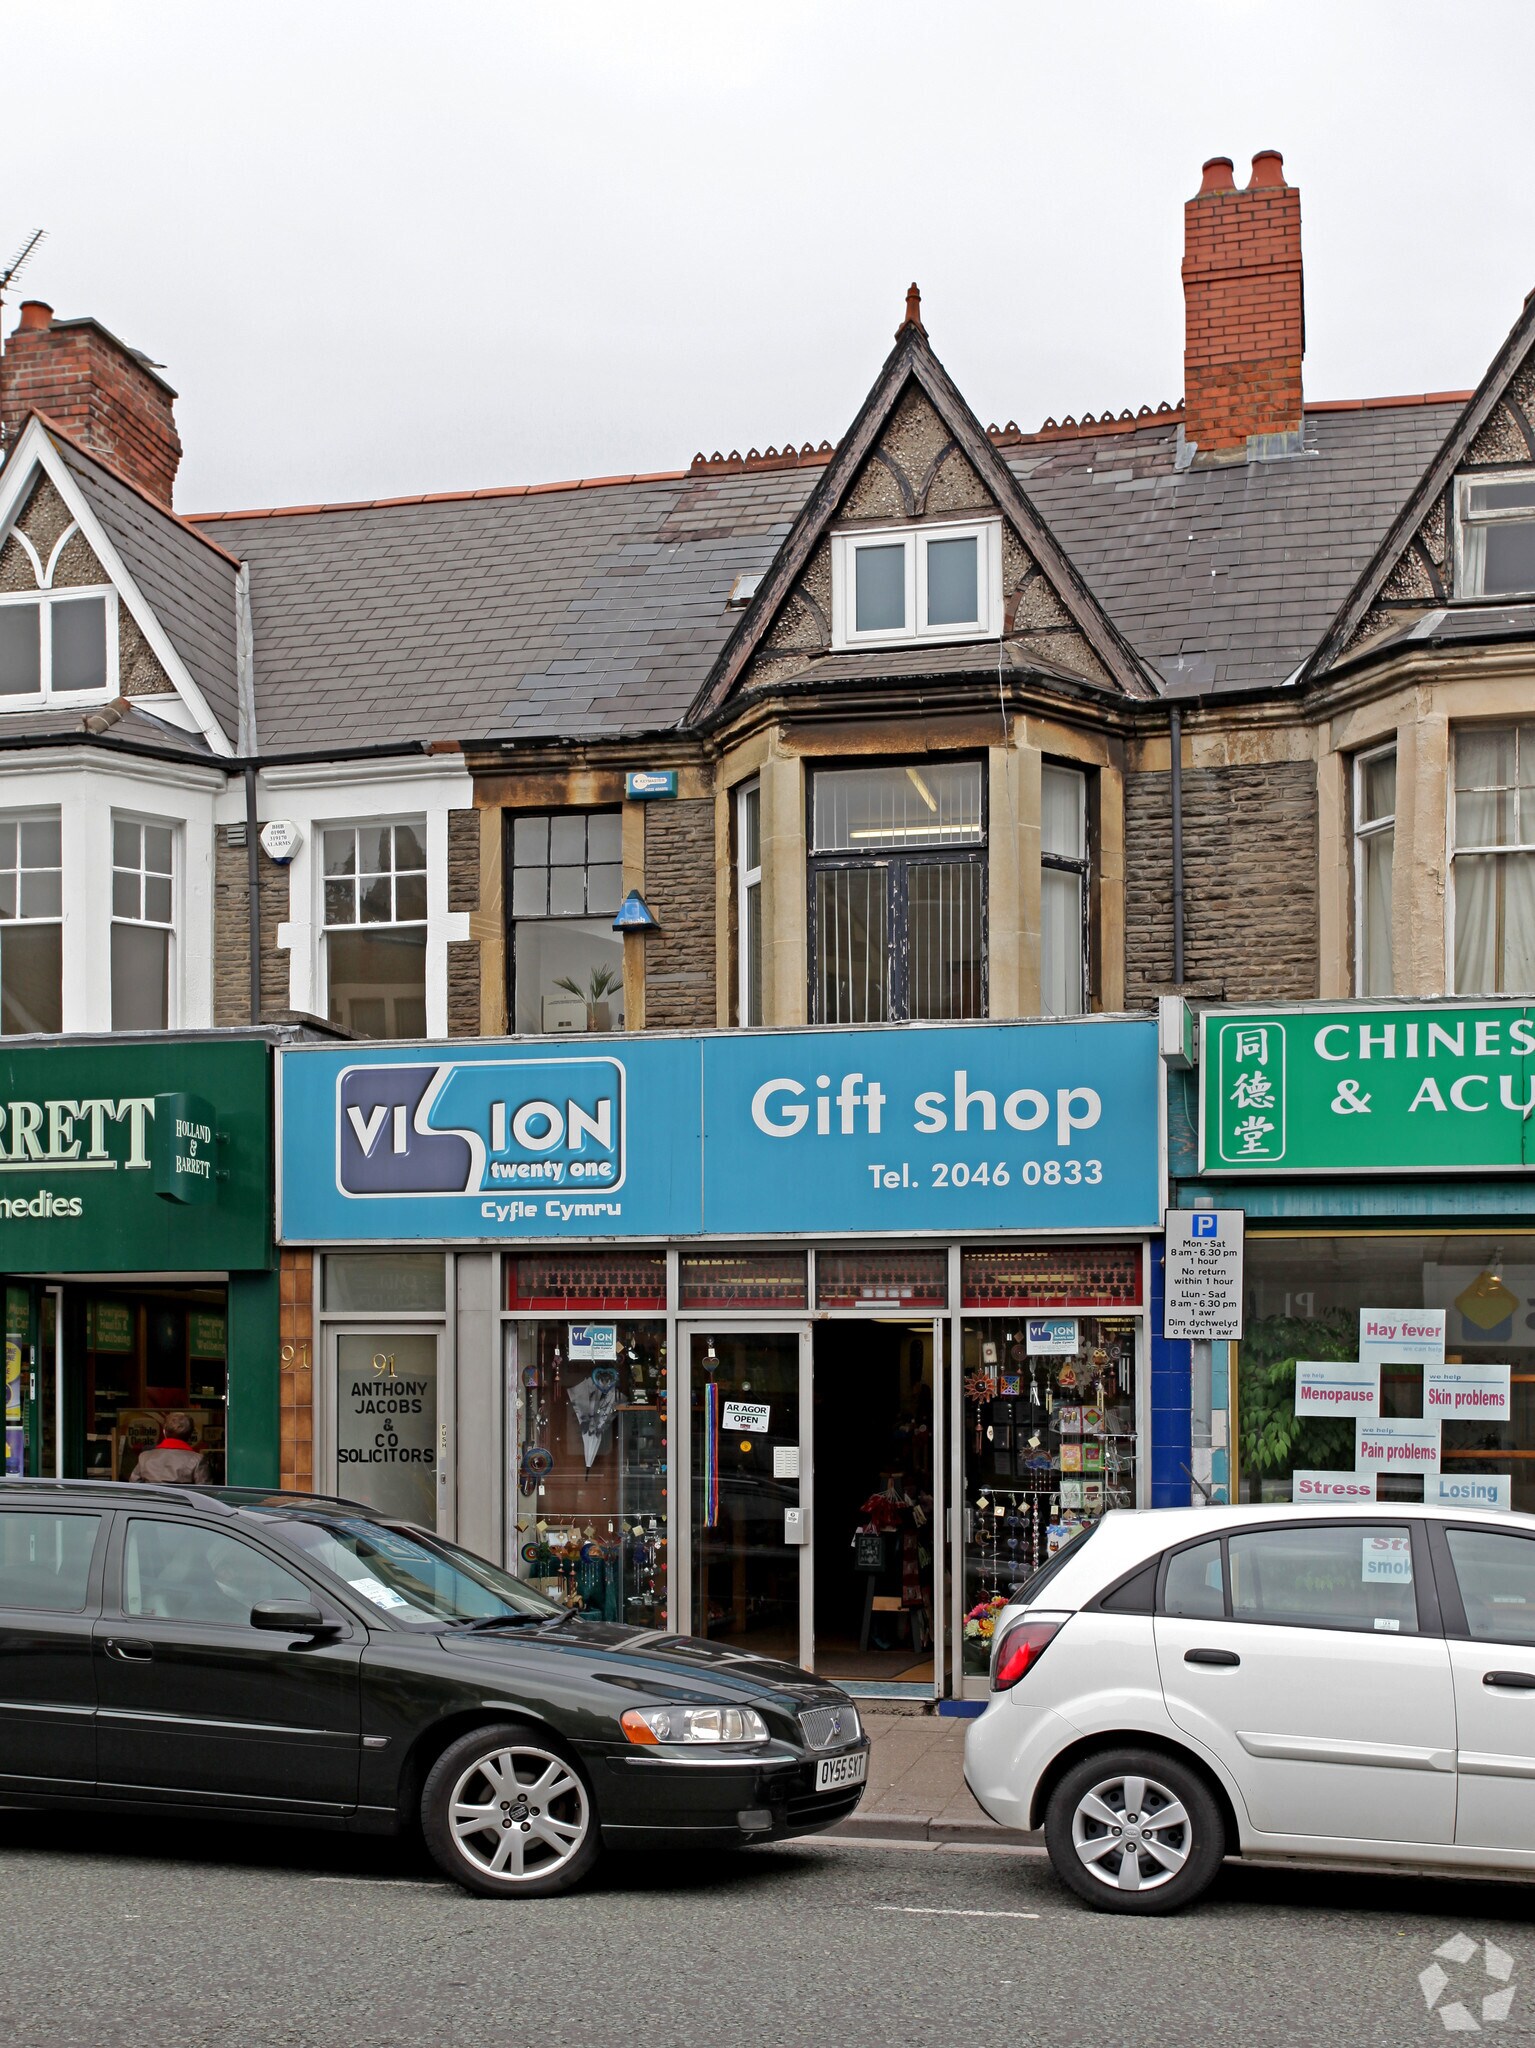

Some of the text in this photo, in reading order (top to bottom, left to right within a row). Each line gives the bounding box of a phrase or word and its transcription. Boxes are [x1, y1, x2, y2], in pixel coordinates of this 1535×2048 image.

[1314, 1019, 1535, 1061] CHINES
[1230, 1028, 1276, 1154] 同德堂
[1330, 1075, 1535, 1114] & ACU
[751, 1070, 1102, 1146] Gift shop
[0, 1097, 155, 1170] RETT
[176, 1119, 210, 1144] HOLLAND
[190, 1139, 198, 1156] &
[176, 1155, 210, 1178] BARRETT
[491, 1161, 612, 1182] twenty one
[868, 1160, 1103, 1188] Tel. 2046 0833
[482, 1200, 621, 1222] Cyfle Cymru
[1198, 1217, 1213, 1236] P
[1190, 1319, 1238, 1328] dychwelyd
[1366, 1322, 1441, 1340] Hay fever
[281, 1344, 310, 1370] 91
[373, 1353, 398, 1378] 91
[351, 1382, 428, 1396] ANTHONY
[1301, 1386, 1374, 1404] Menopause
[1428, 1388, 1505, 1409] Skin problems
[355, 1399, 422, 1414] JACOBS
[384, 1418, 394, 1432] &
[734, 1415, 758, 1424] OPEN
[338, 1448, 434, 1463] SOLICITORS
[1361, 1441, 1436, 1462] Pain problems
[1299, 1480, 1370, 1496] Stress
[1439, 1480, 1497, 1502] Losing
[822, 1758, 846, 1784] OY55
